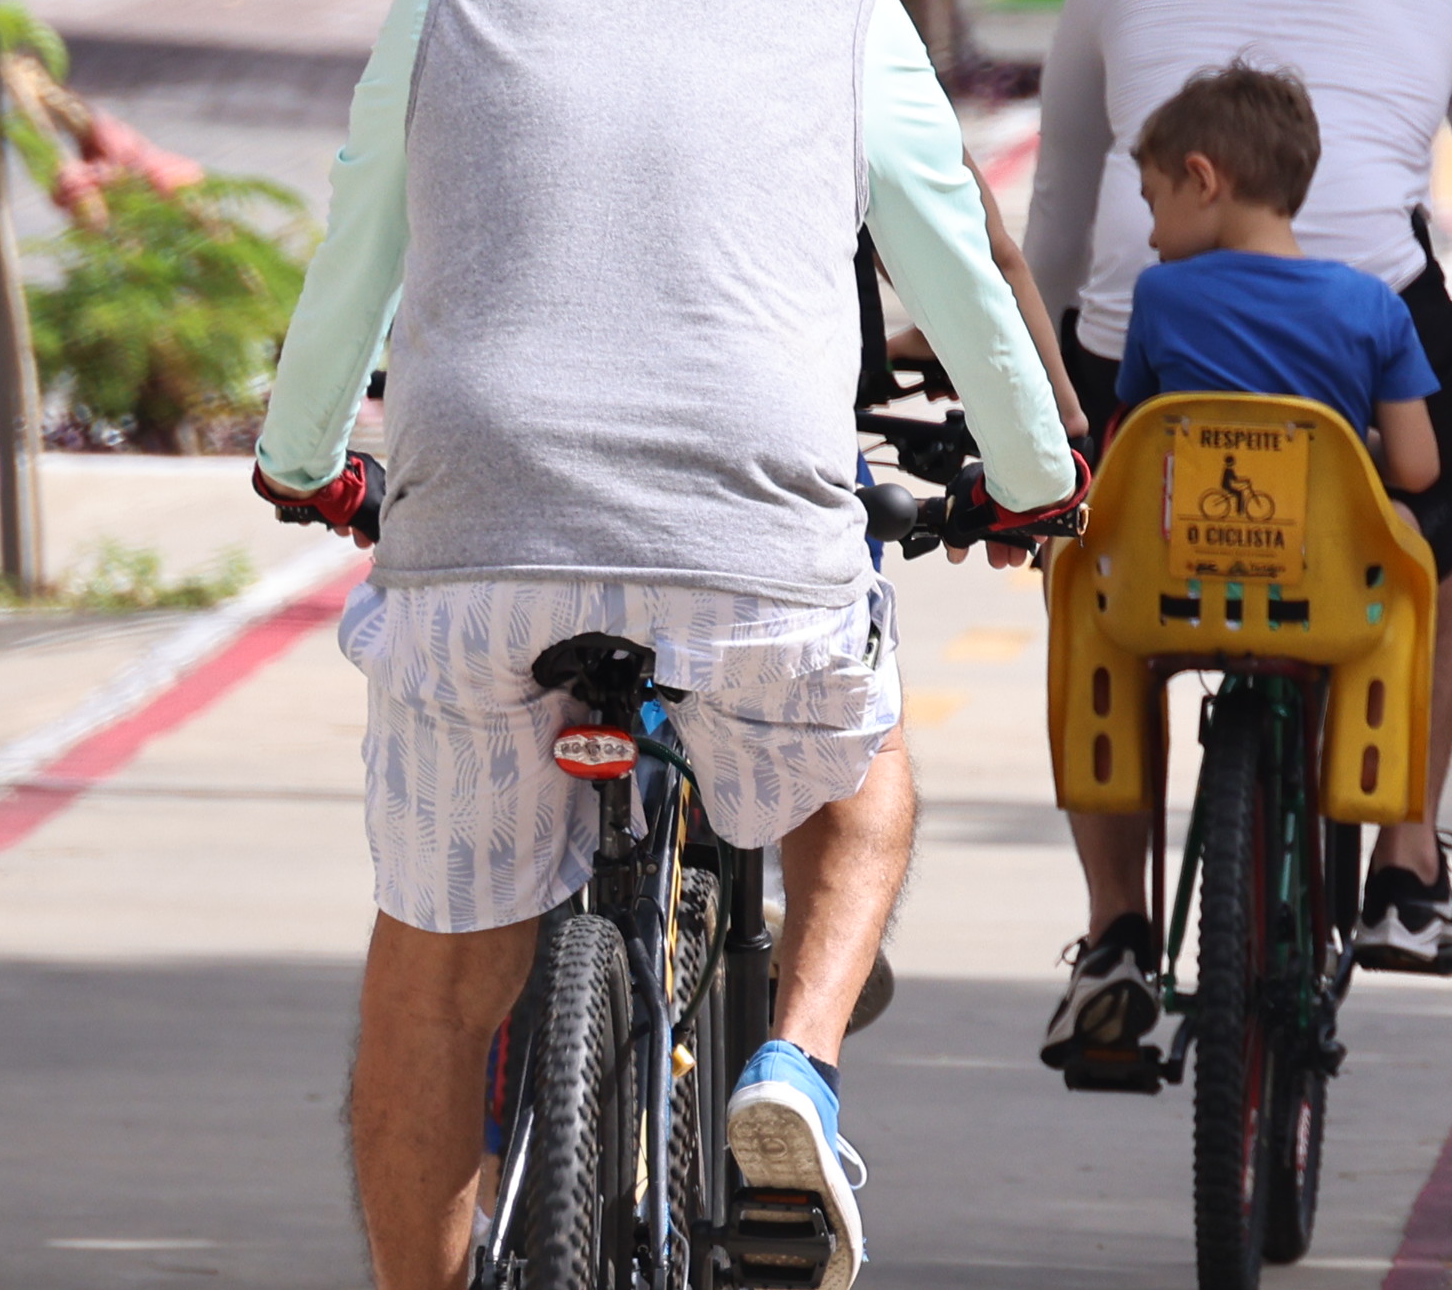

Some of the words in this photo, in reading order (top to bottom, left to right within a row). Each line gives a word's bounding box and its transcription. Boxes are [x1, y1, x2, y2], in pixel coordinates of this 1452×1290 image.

[1201, 429, 1282, 451] RESPEITE
[1188, 526, 1199, 544] O
[1206, 527, 1285, 549] CICLISTA
